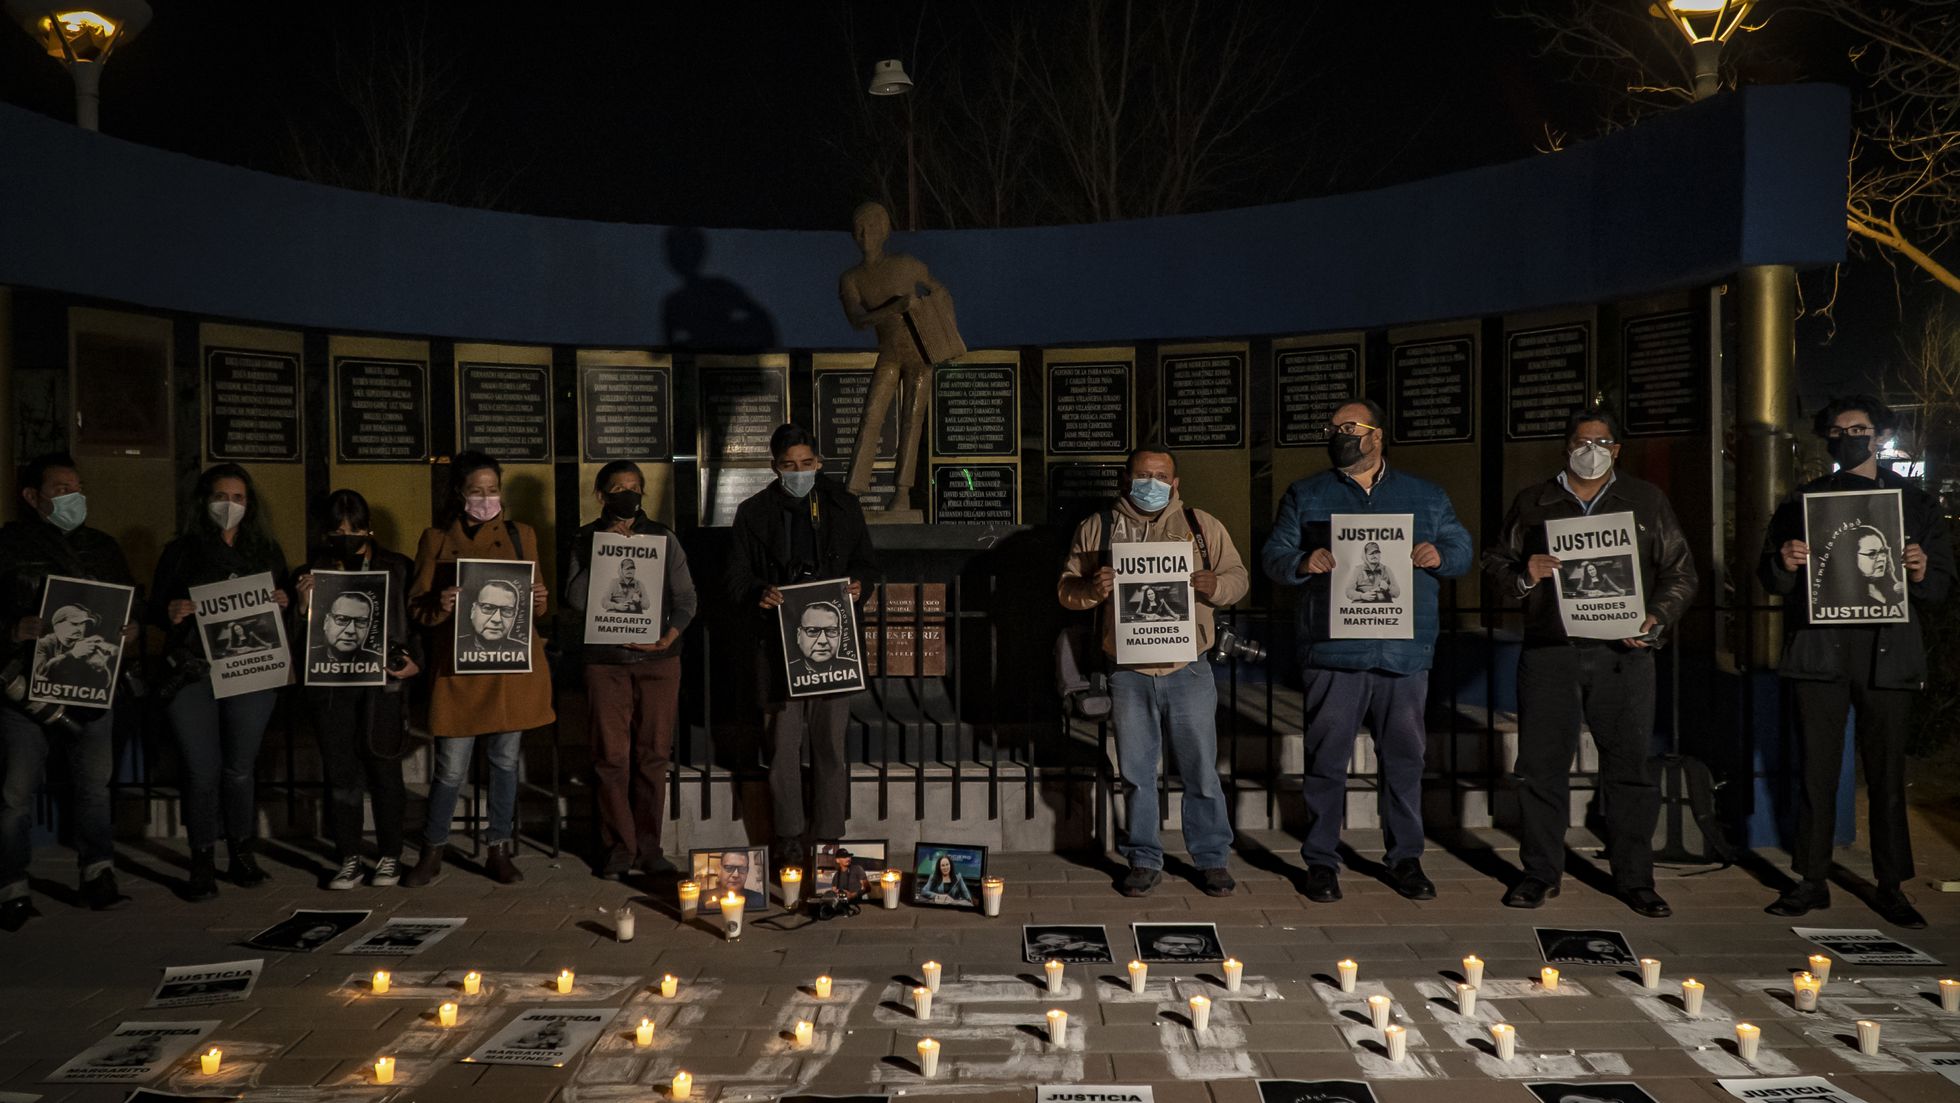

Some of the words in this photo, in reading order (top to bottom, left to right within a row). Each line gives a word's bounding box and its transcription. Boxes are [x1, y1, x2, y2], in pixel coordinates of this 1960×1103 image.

[1337, 527, 1405, 541] JUSTICIA
[1552, 528, 1631, 553] JUSTICIA
[597, 544, 659, 560] JUSTICIA
[1116, 555, 1189, 575] JUSTICIA
[198, 587, 273, 616] JUSTICIA
[1575, 601, 1627, 612] LOURDES
[1339, 606, 1403, 615] MARGARITO
[1571, 611, 1638, 622] MALDONADO
[1815, 604, 1903, 619] JUSTICIA
[594, 614, 653, 625] MARGARITO
[1343, 615, 1399, 626] MARTÍNEZ
[597, 623, 648, 634] MARTÍNEZ
[1132, 626, 1180, 636] LOURDES
[1126, 635, 1190, 647] MALDONADO
[226, 653, 274, 669] LOURDES
[459, 651, 527, 663] JUSTICIA
[221, 661, 286, 680] MALDONADO
[310, 662, 381, 674] JUSTICIA
[793, 668, 858, 687] JUSTICIA
[32, 679, 108, 701] JUSTICIA
[165, 970, 253, 983] JUSTICIA
[114, 1028, 200, 1037] JUSTICIA
[1045, 1094, 1142, 1102] JUSTICIA
[1742, 1086, 1835, 1098] JUSTICIA
